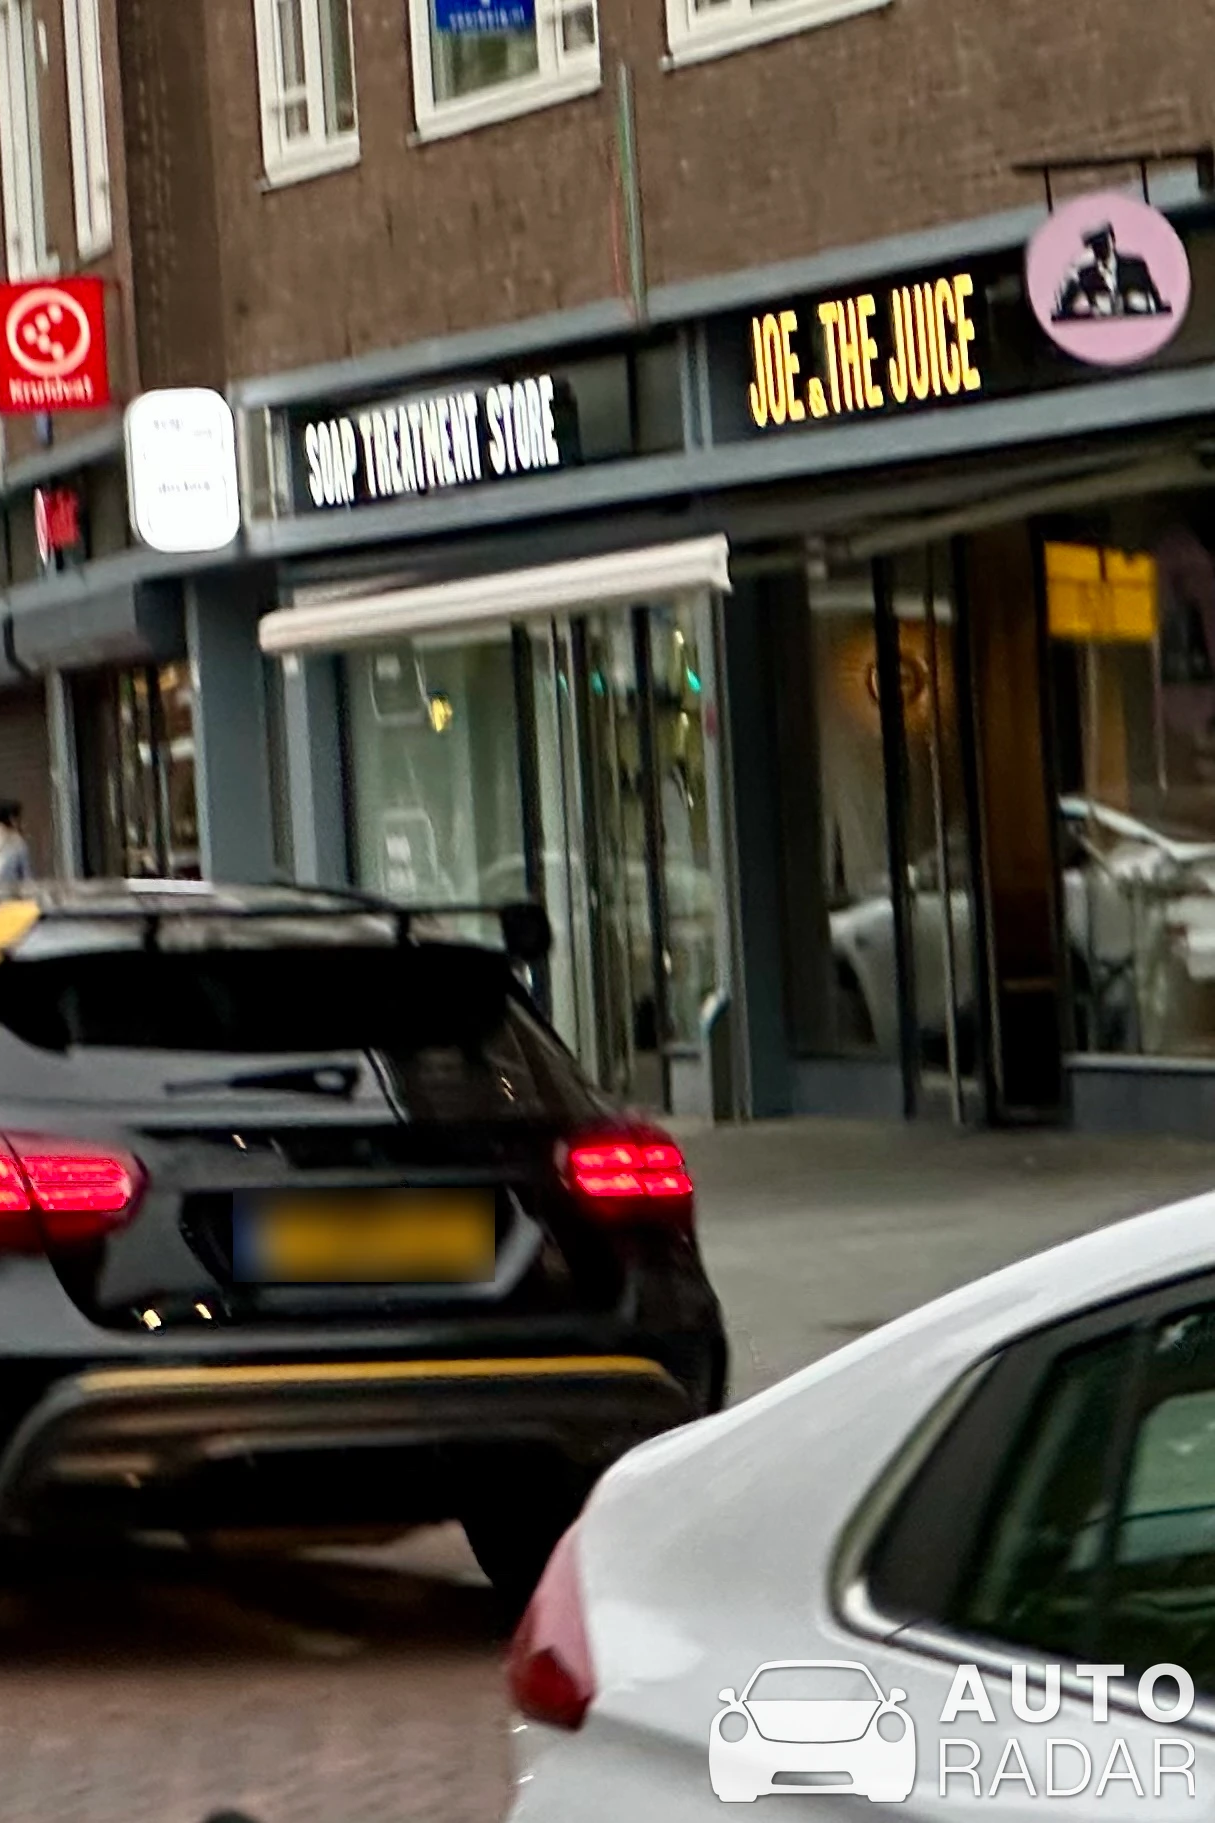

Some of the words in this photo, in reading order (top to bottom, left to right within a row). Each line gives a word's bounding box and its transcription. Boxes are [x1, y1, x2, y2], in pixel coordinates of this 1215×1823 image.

[749, 310, 806, 428] JOE
[807, 377, 829, 419] &
[818, 294, 884, 414] THE
[889, 273, 982, 404] JUICE
[304, 416, 358, 507] SOAP
[358, 391, 482, 499] TREATMENT
[485, 374, 560, 476] STORE
